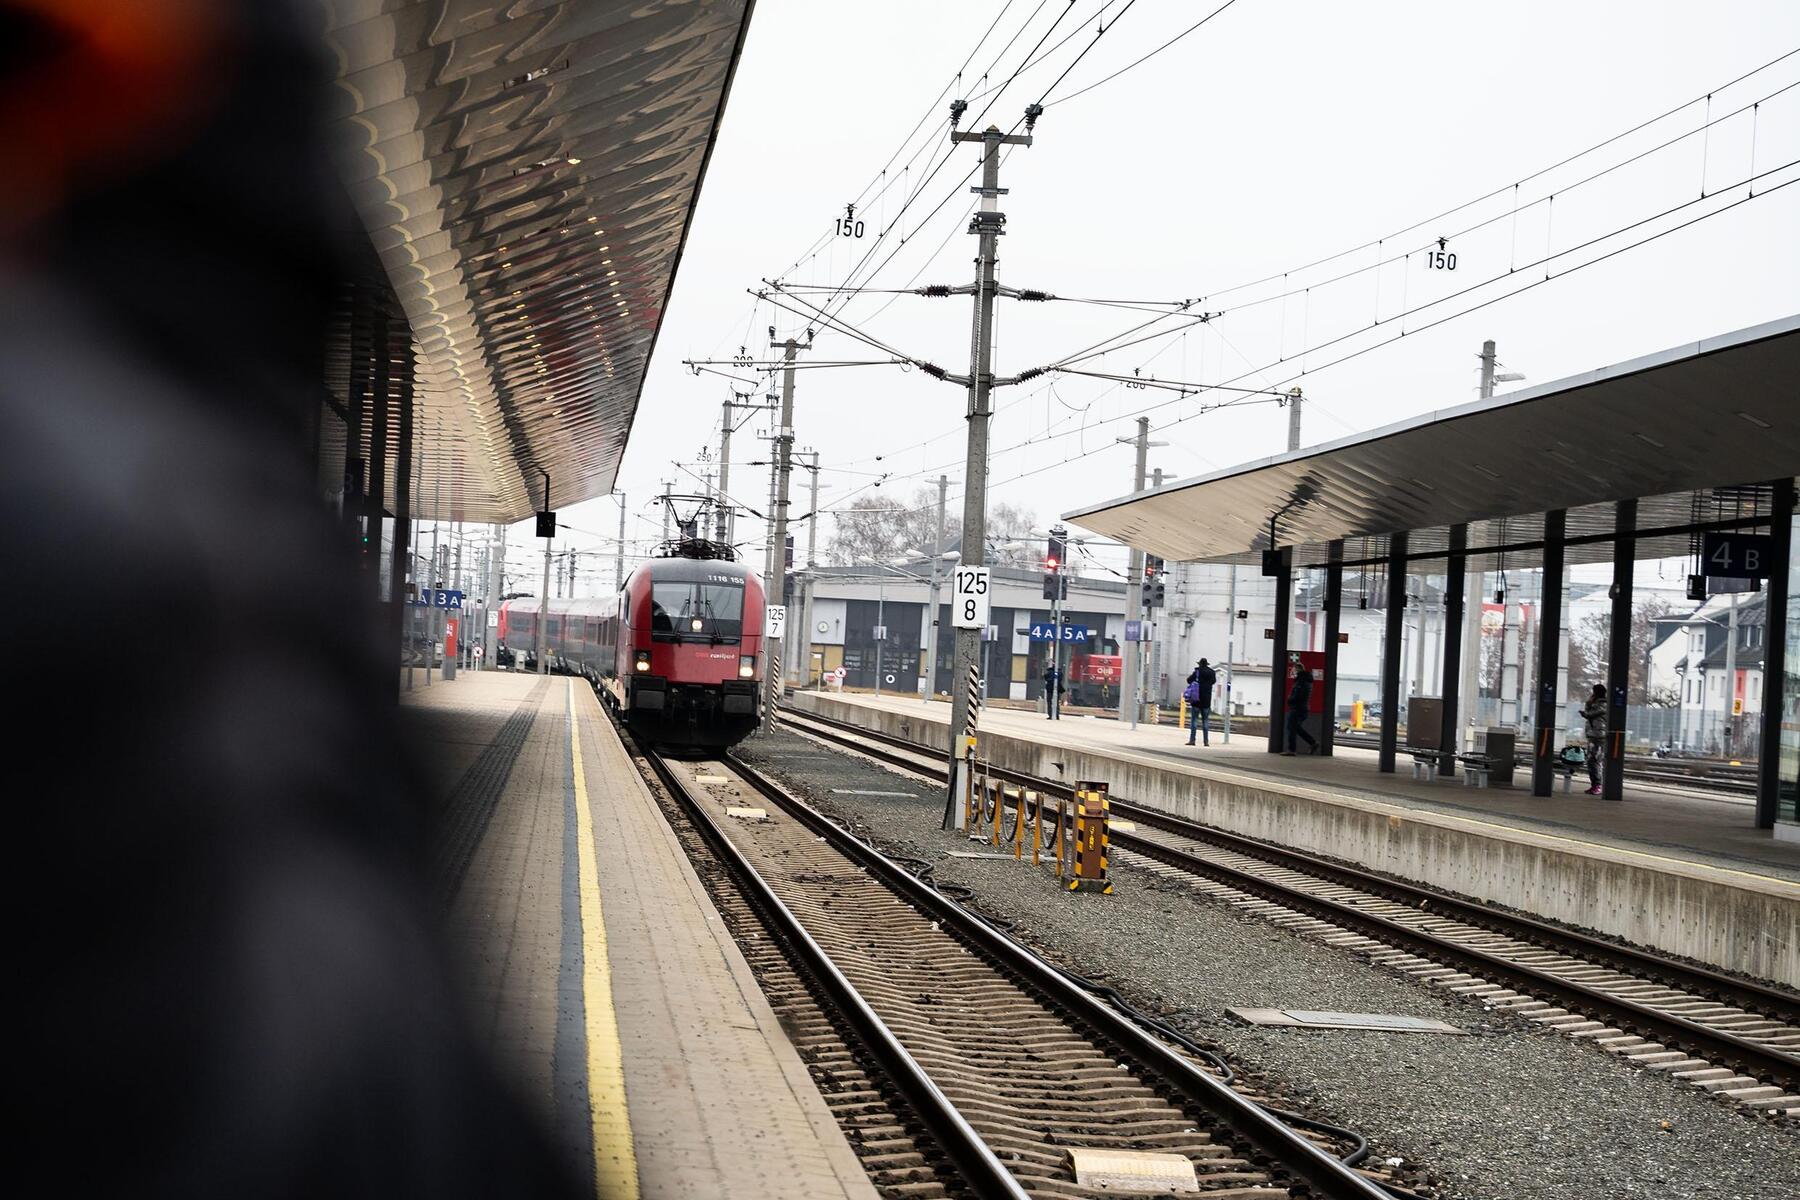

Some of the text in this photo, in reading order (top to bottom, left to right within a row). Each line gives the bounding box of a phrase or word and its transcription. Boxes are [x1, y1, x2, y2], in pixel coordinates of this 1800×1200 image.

[836, 218, 864, 238] 150
[1428, 251, 1457, 271] 150
[733, 355, 753, 367] 200
[1711, 541, 1760, 570] 4 B
[708, 575, 745, 584] 1116 155
[957, 571, 988, 595] 125
[438, 592, 459, 606] 3 A
[768, 608, 784, 621] 125
[964, 599, 976, 621] 8
[772, 622, 778, 634] 7
[1031, 626, 1054, 639] 4 A
[1064, 628, 1085, 640] 5 A
